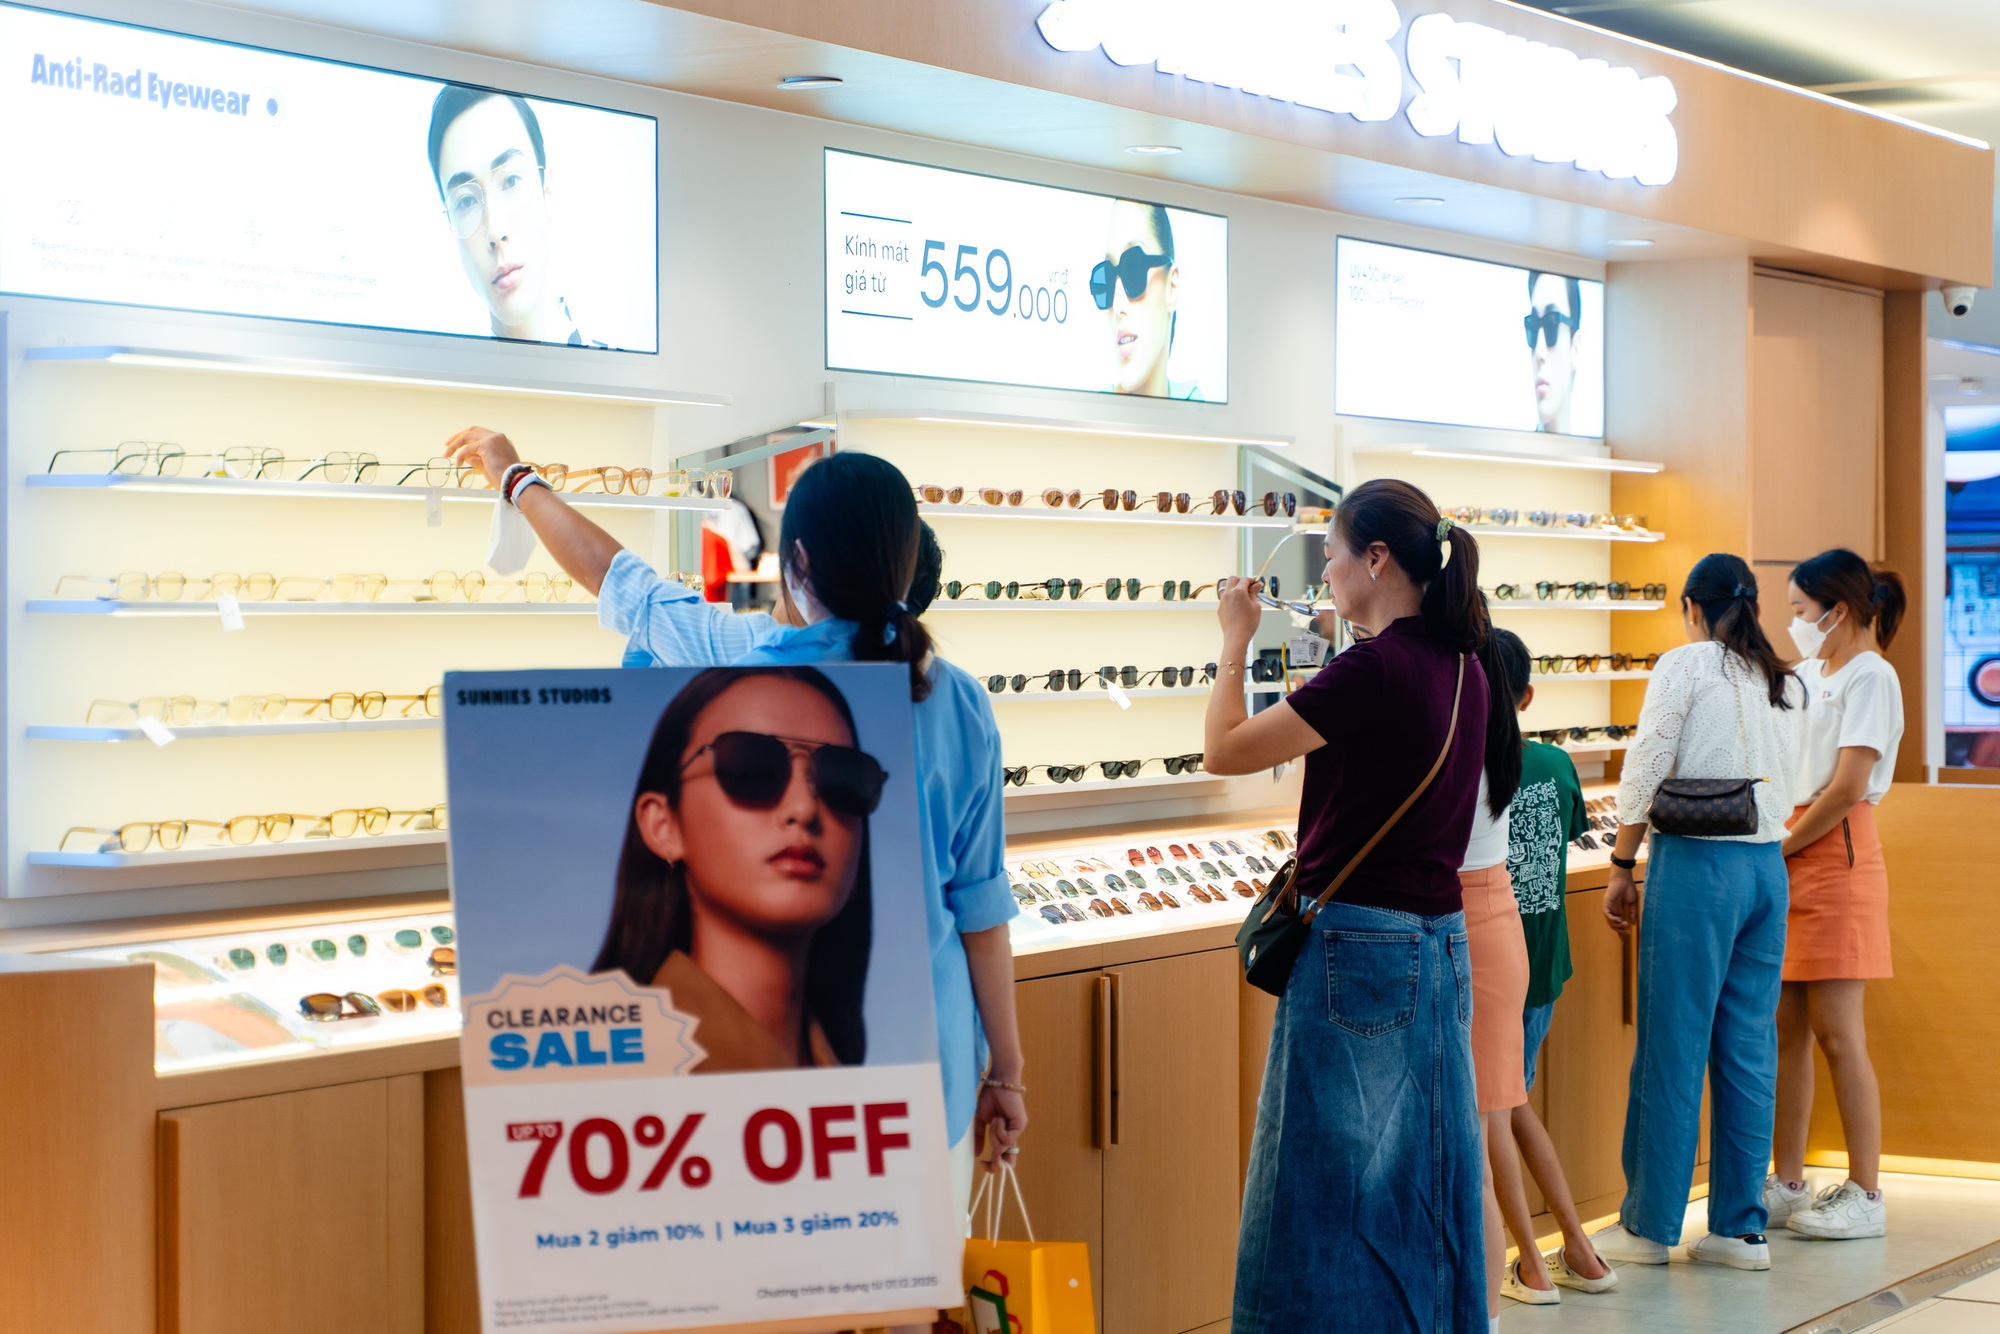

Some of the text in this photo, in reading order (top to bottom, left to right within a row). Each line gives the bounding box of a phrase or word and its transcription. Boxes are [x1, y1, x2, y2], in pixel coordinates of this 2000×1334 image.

[31, 53, 251, 118] Anti-Rad Eyewear
[845, 234, 910, 263] Kính mát
[845, 269, 888, 295] giá từ
[919, 238, 1069, 325] 559.000
[456, 685, 613, 706] SUNNIES STUDIOS
[487, 1004, 642, 1029] CLEARANCE
[489, 1028, 645, 1071] SALE
[511, 1124, 558, 1141] UP TO
[506, 1102, 910, 1198] 70% OFF
[536, 1233, 582, 1249] Mua
[588, 1230, 600, 1247] 2
[665, 1223, 705, 1241] 10%
[733, 1220, 778, 1236] Mua
[783, 1216, 796, 1233] 3
[857, 1210, 899, 1228] 20%
